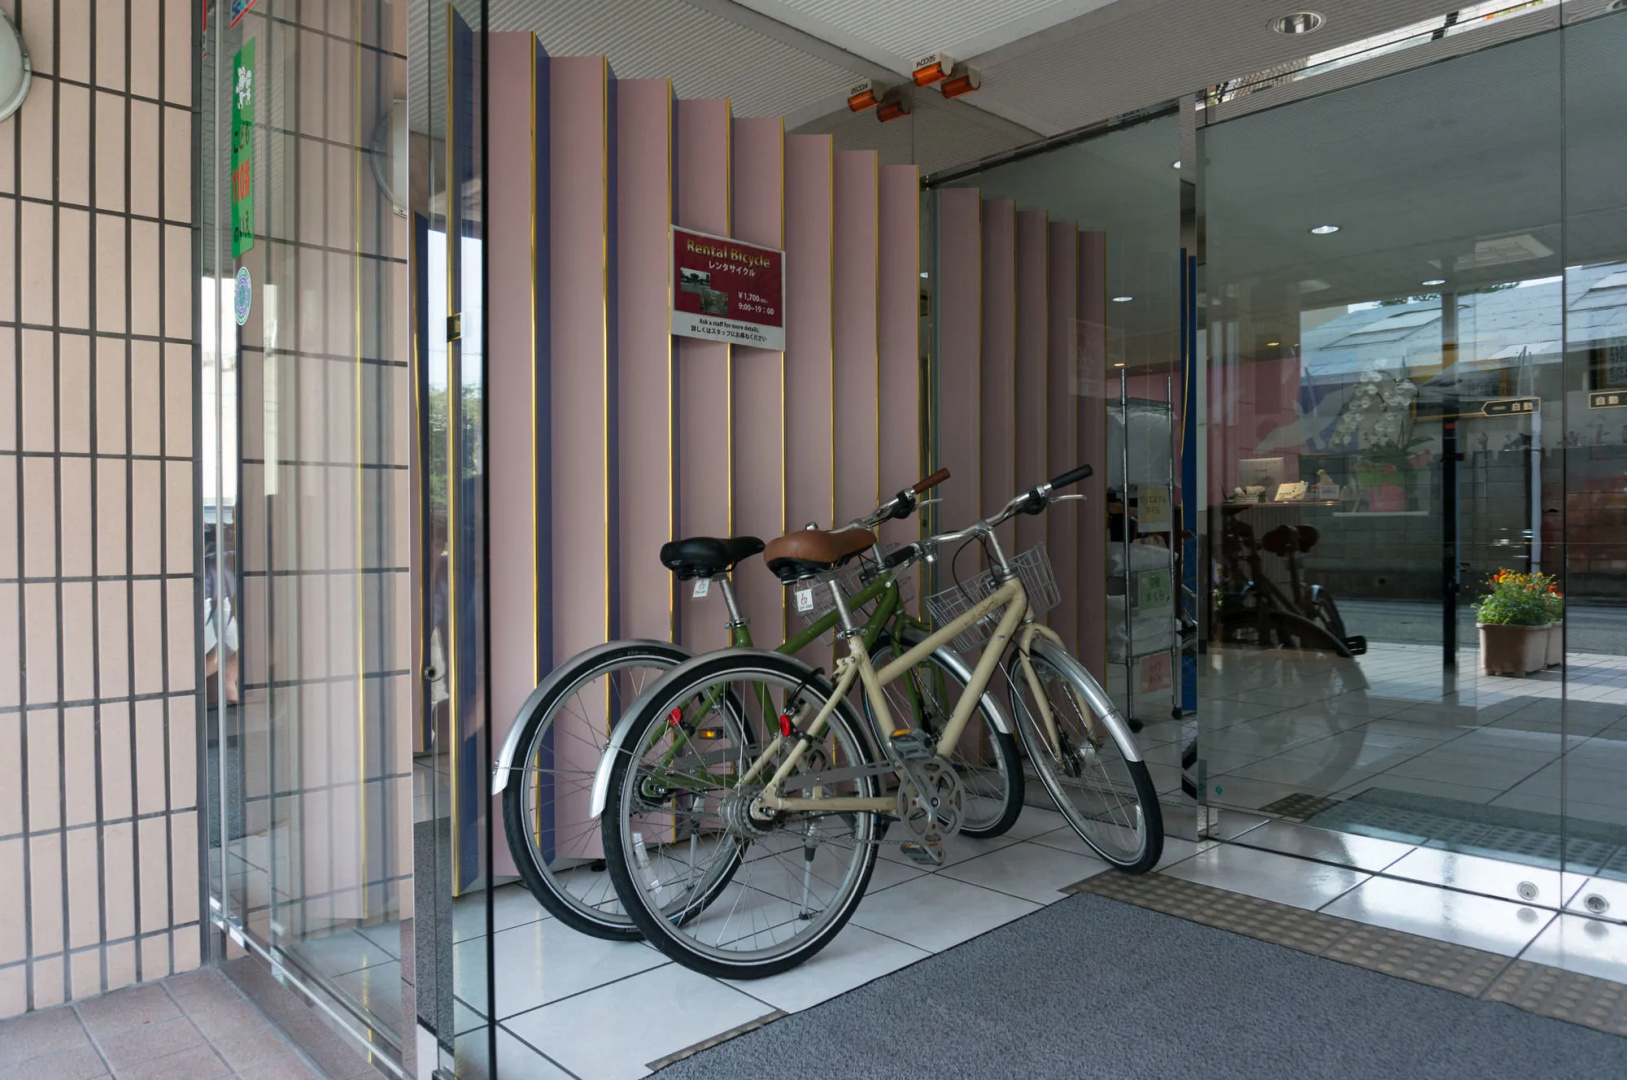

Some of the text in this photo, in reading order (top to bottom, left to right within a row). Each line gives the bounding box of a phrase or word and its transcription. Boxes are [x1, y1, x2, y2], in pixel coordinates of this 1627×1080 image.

[233, 125, 250, 154] こども
[232, 157, 250, 204] 110番
[687, 239, 771, 268] Rental Bicycle
[708, 260, 756, 277] レンタサイクル
